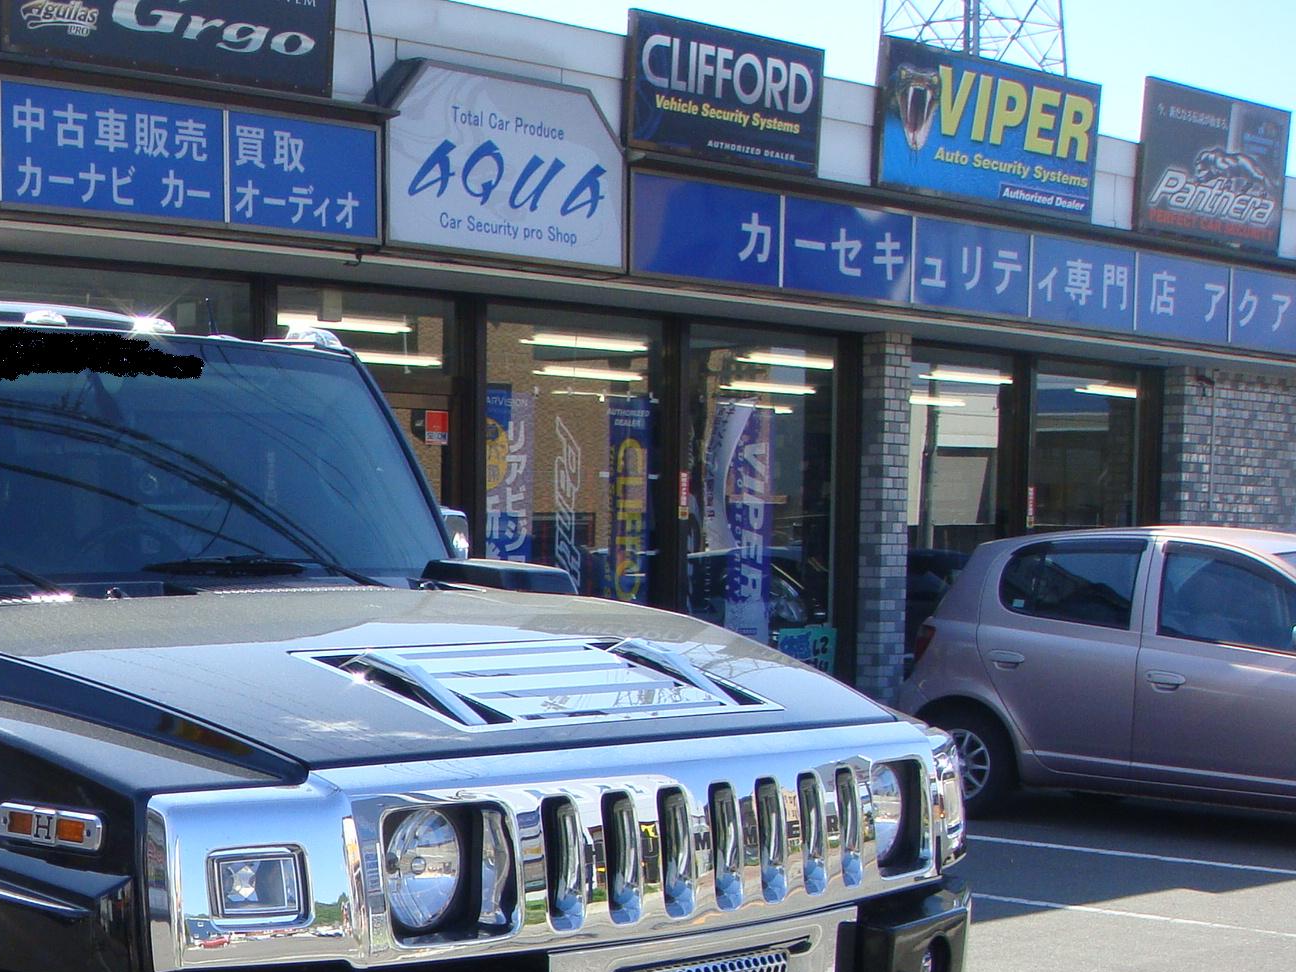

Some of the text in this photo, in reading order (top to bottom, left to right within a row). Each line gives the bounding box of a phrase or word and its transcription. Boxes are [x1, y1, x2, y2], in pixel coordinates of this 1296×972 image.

[67, 25, 91, 36] PRO
[111, 0, 316, 56] Grgo
[641, 34, 814, 114] CLIFFORD
[12, 98, 306, 173] 中古車販売 買取
[451, 105, 565, 140] Total Car Produce
[655, 94, 800, 134] Vehicle Security Systems
[938, 65, 1094, 163] VIPER
[707, 139, 796, 161] AUTHORIZED DEALER
[934, 147, 1088, 188] Auto Security Systems
[16, 156, 136, 206] カーナビ
[408, 139, 607, 219] AQUA
[1002, 187, 1085, 211] Authorized Dealer
[439, 212, 577, 246] Car Security pro Shop
[738, 212, 1292, 332] カーセキュリティ専門店 アクア
[740, 441, 768, 600] VIPER
[34, 814, 53, 840] H
